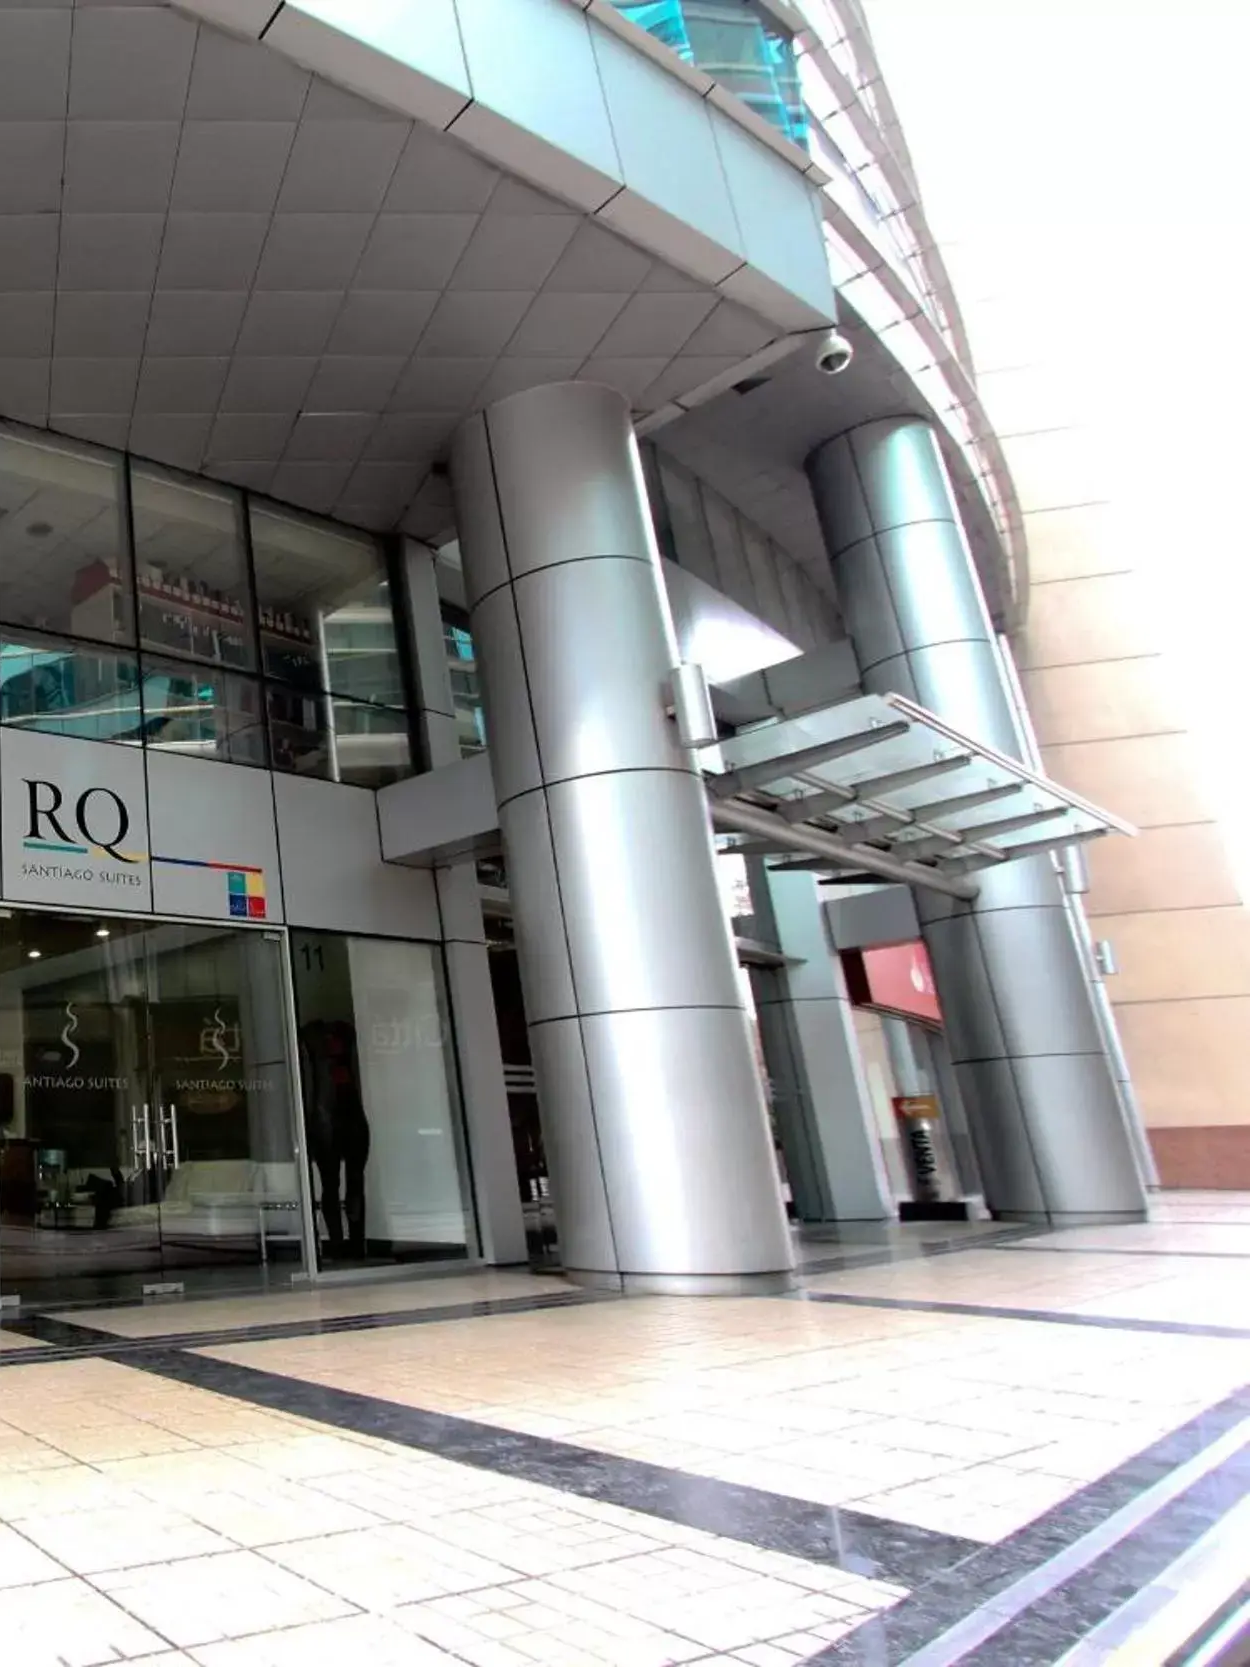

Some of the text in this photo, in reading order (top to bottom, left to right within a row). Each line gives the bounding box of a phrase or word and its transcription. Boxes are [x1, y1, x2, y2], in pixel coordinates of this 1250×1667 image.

[21, 778, 140, 864] RQ
[21, 862, 141, 887] SANTIAGO SUITES
[299, 944, 325, 972] 11
[16, 1074, 129, 1090] ANTIAGO SUITES
[175, 1078, 236, 1092] SANTIAGO
